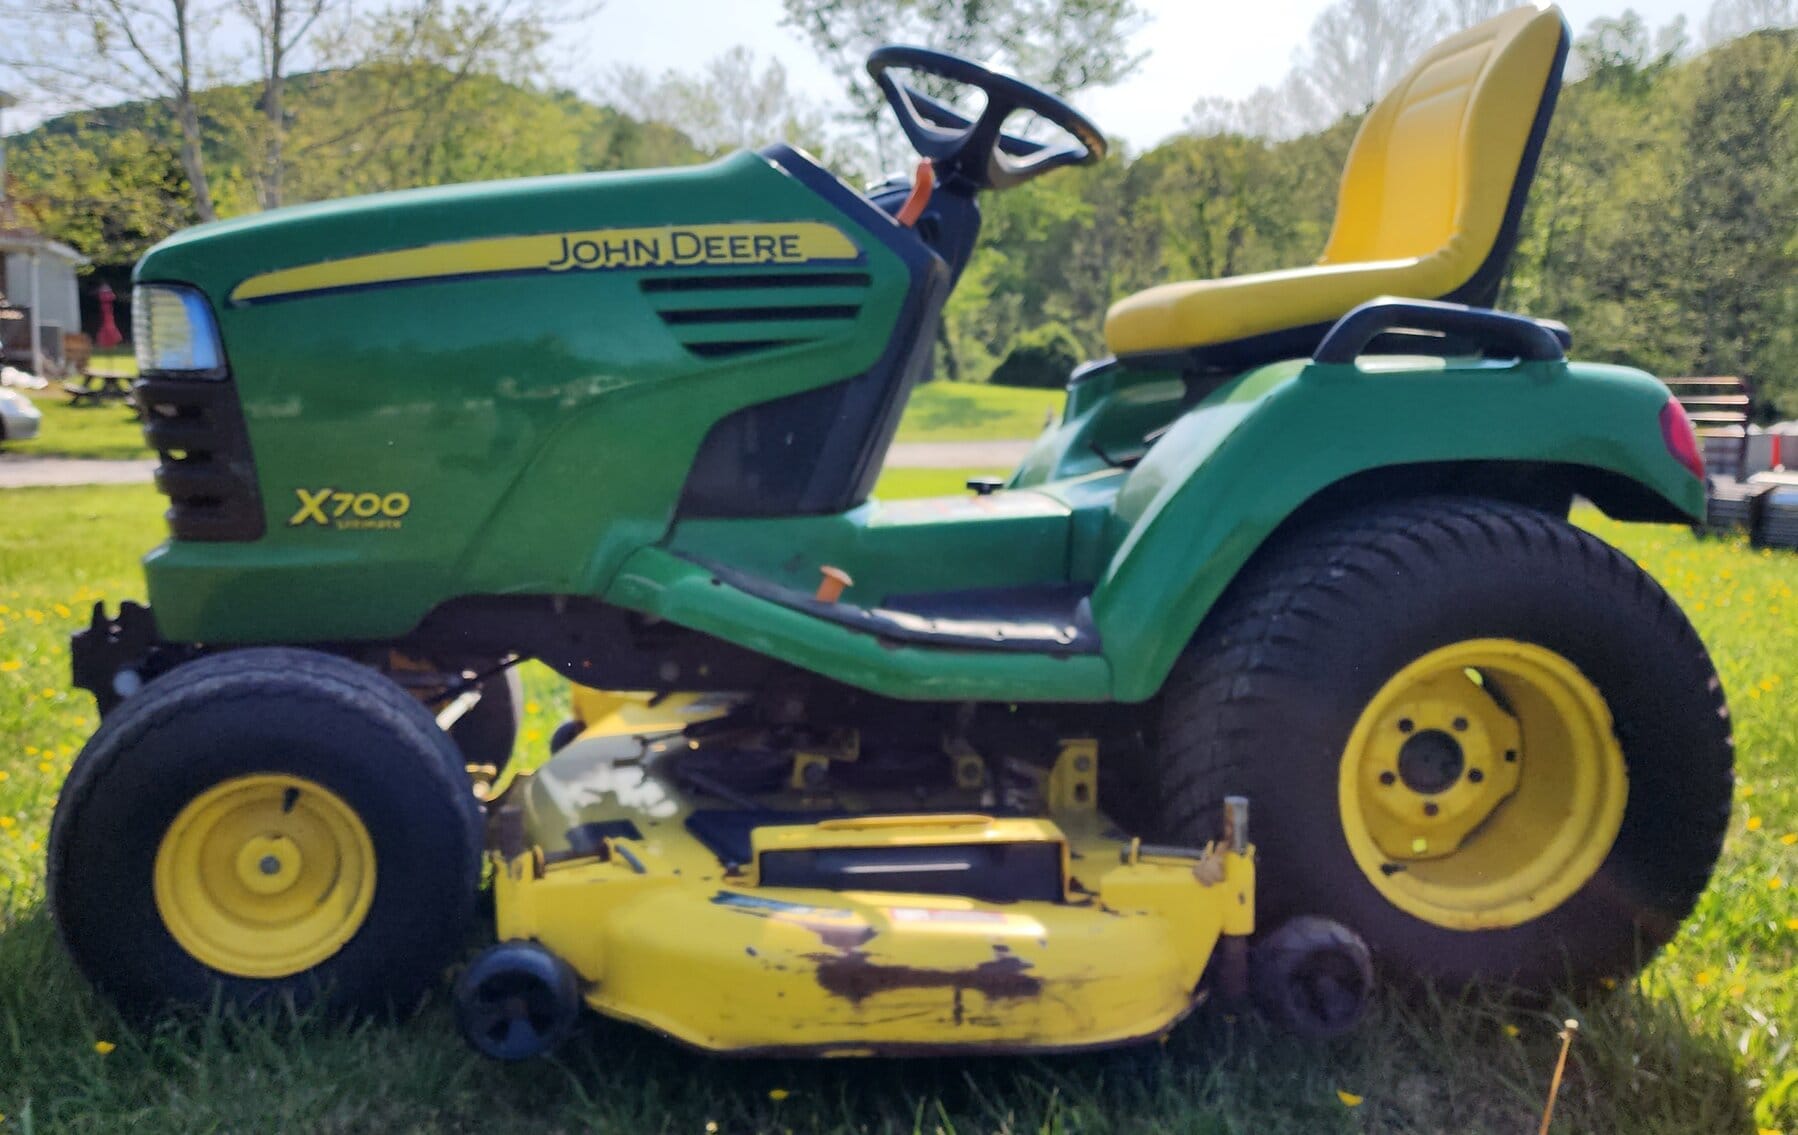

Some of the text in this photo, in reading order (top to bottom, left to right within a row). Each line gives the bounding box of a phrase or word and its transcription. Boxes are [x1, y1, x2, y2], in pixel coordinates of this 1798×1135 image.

[549, 231, 803, 265] JOHN DEERE
[290, 488, 411, 525] X700
